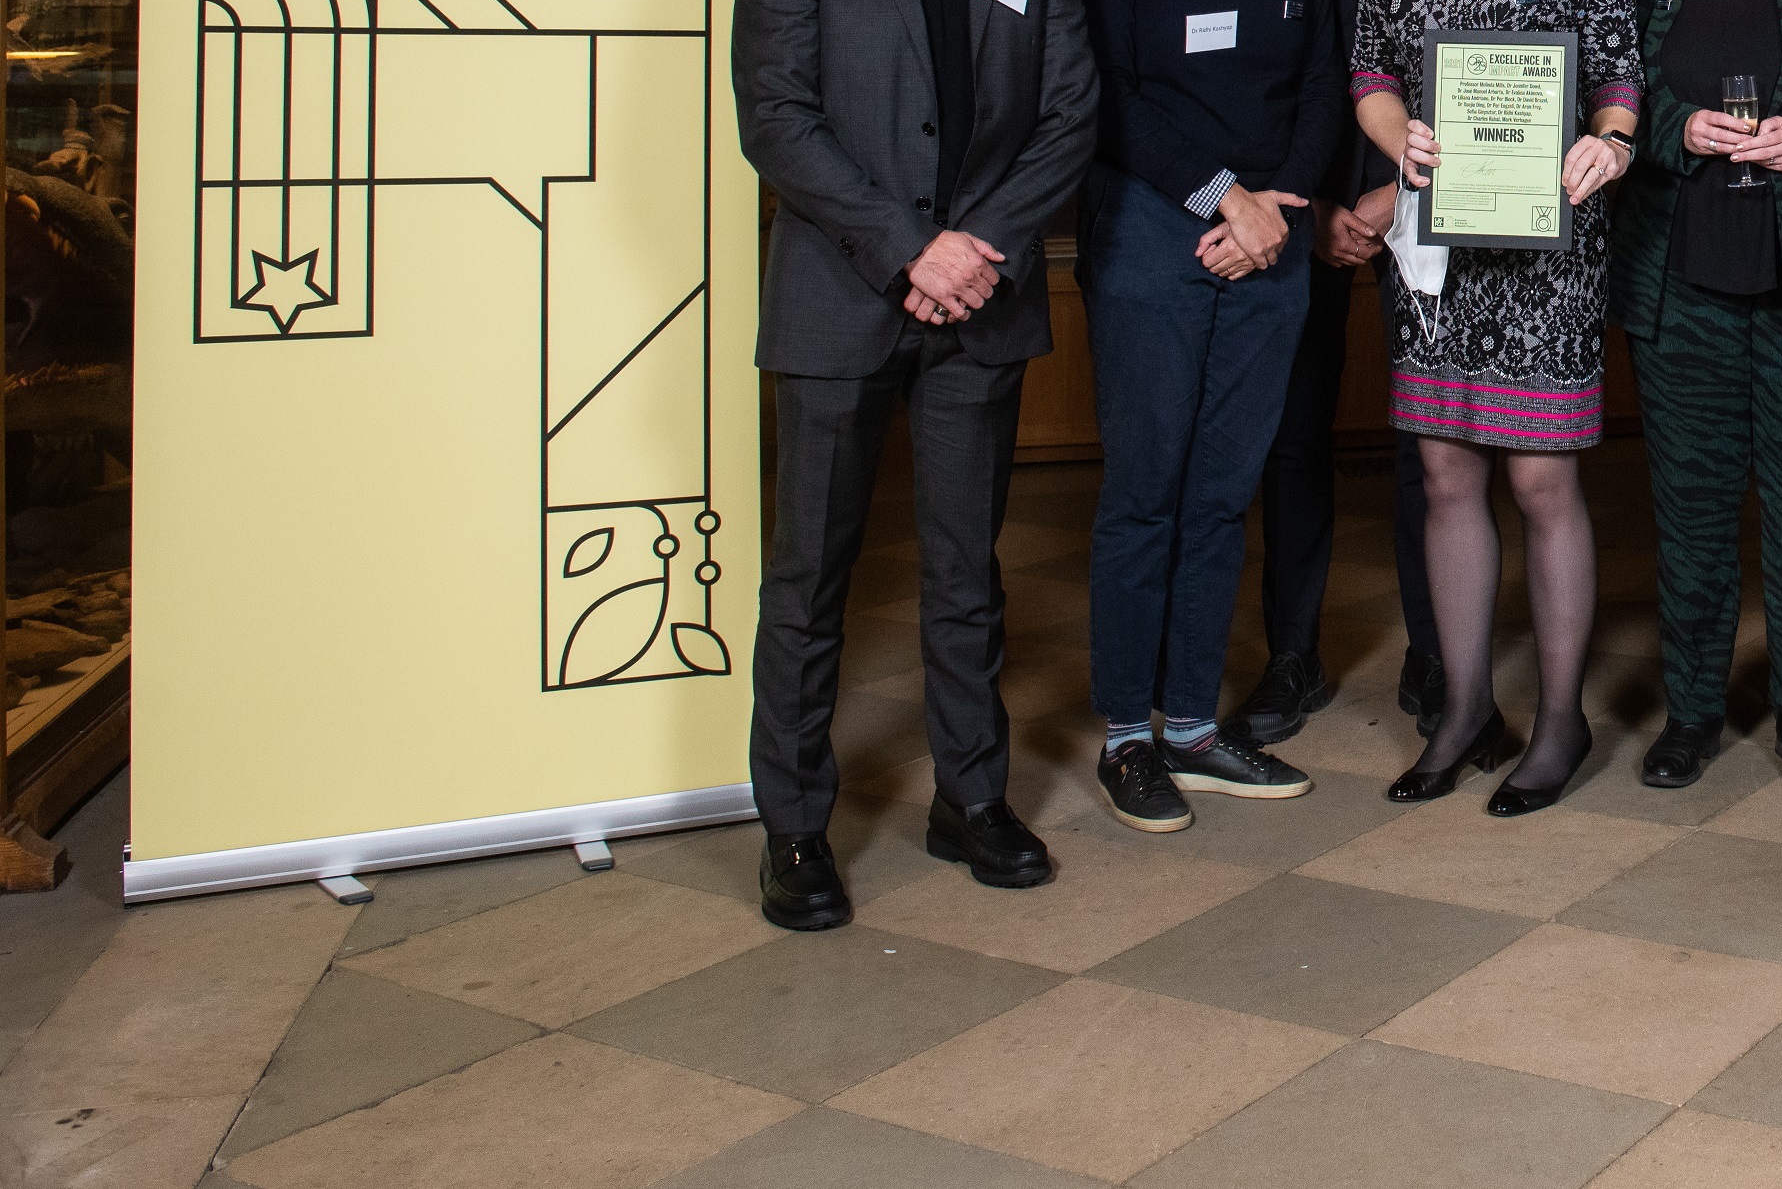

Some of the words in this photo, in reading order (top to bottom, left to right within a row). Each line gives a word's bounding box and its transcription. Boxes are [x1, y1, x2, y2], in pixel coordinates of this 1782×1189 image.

[1444, 58, 1462, 68] 2021
[1490, 54, 1539, 65] EXCELLENCE
[1543, 56, 1551, 65] IN
[1489, 65, 1520, 76] IMPACT
[1523, 67, 1556, 77] AWARDS
[1474, 128, 1524, 143] WINNERS
